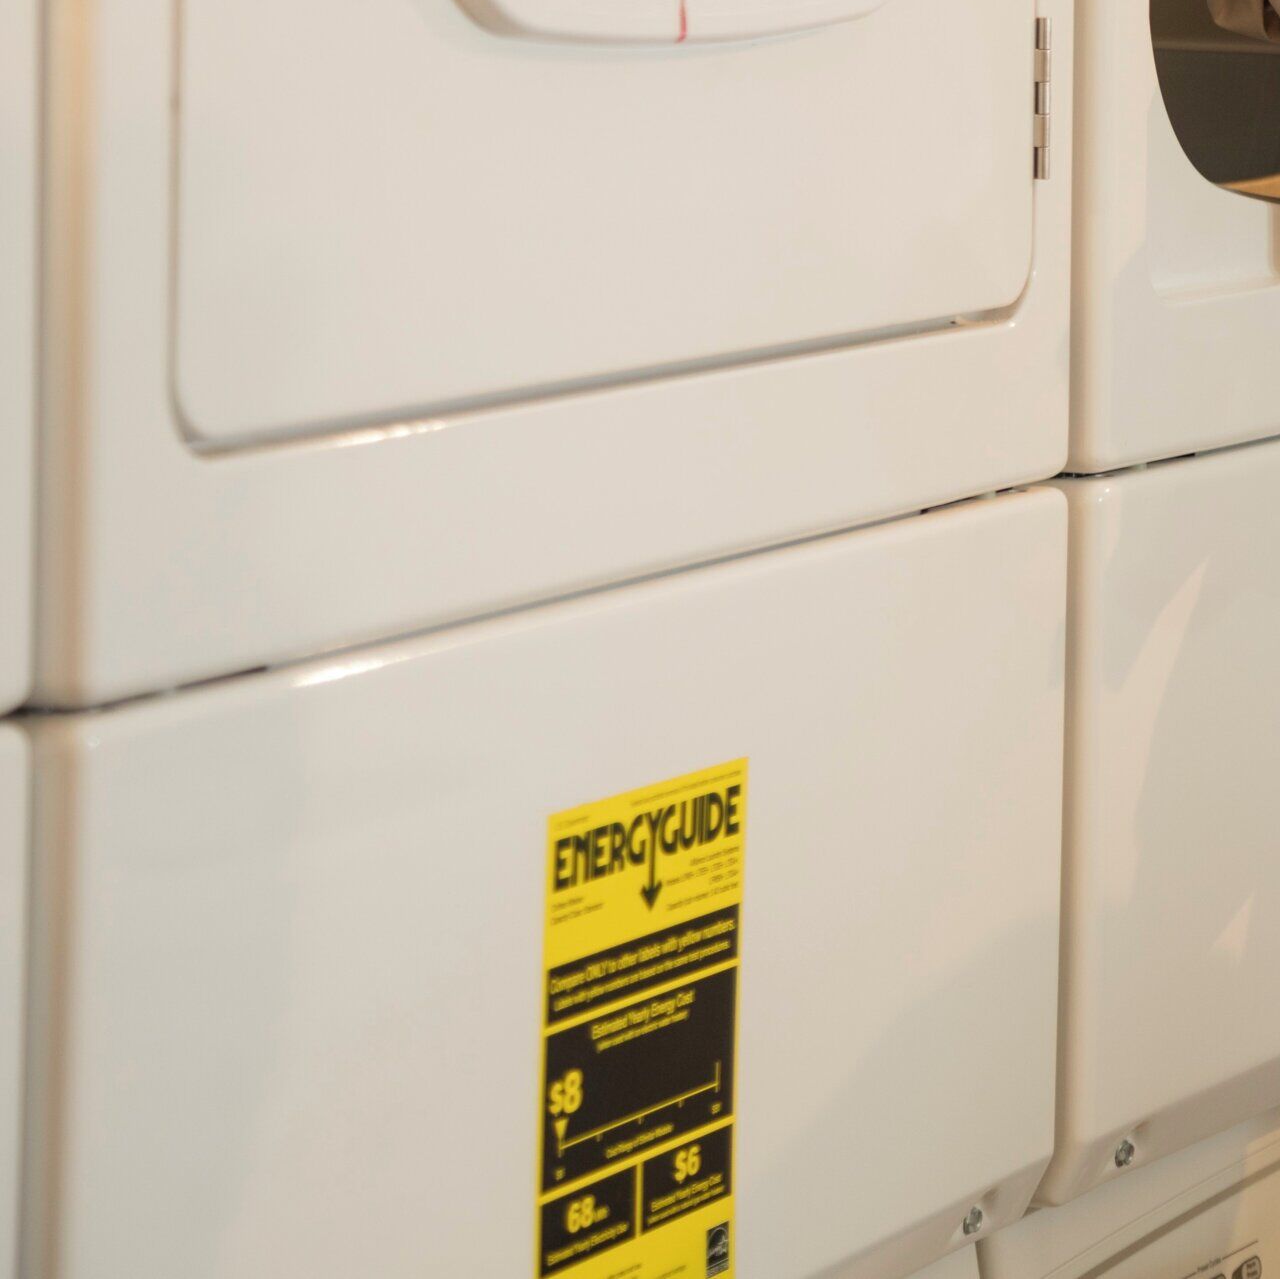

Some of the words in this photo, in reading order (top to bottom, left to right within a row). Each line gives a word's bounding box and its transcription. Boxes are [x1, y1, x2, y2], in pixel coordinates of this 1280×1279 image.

[554, 785, 740, 890] ENERGYGUIDE
[549, 1069, 582, 1115] $8
[674, 1144, 700, 1183] $6
[567, 1196, 595, 1234] 68
